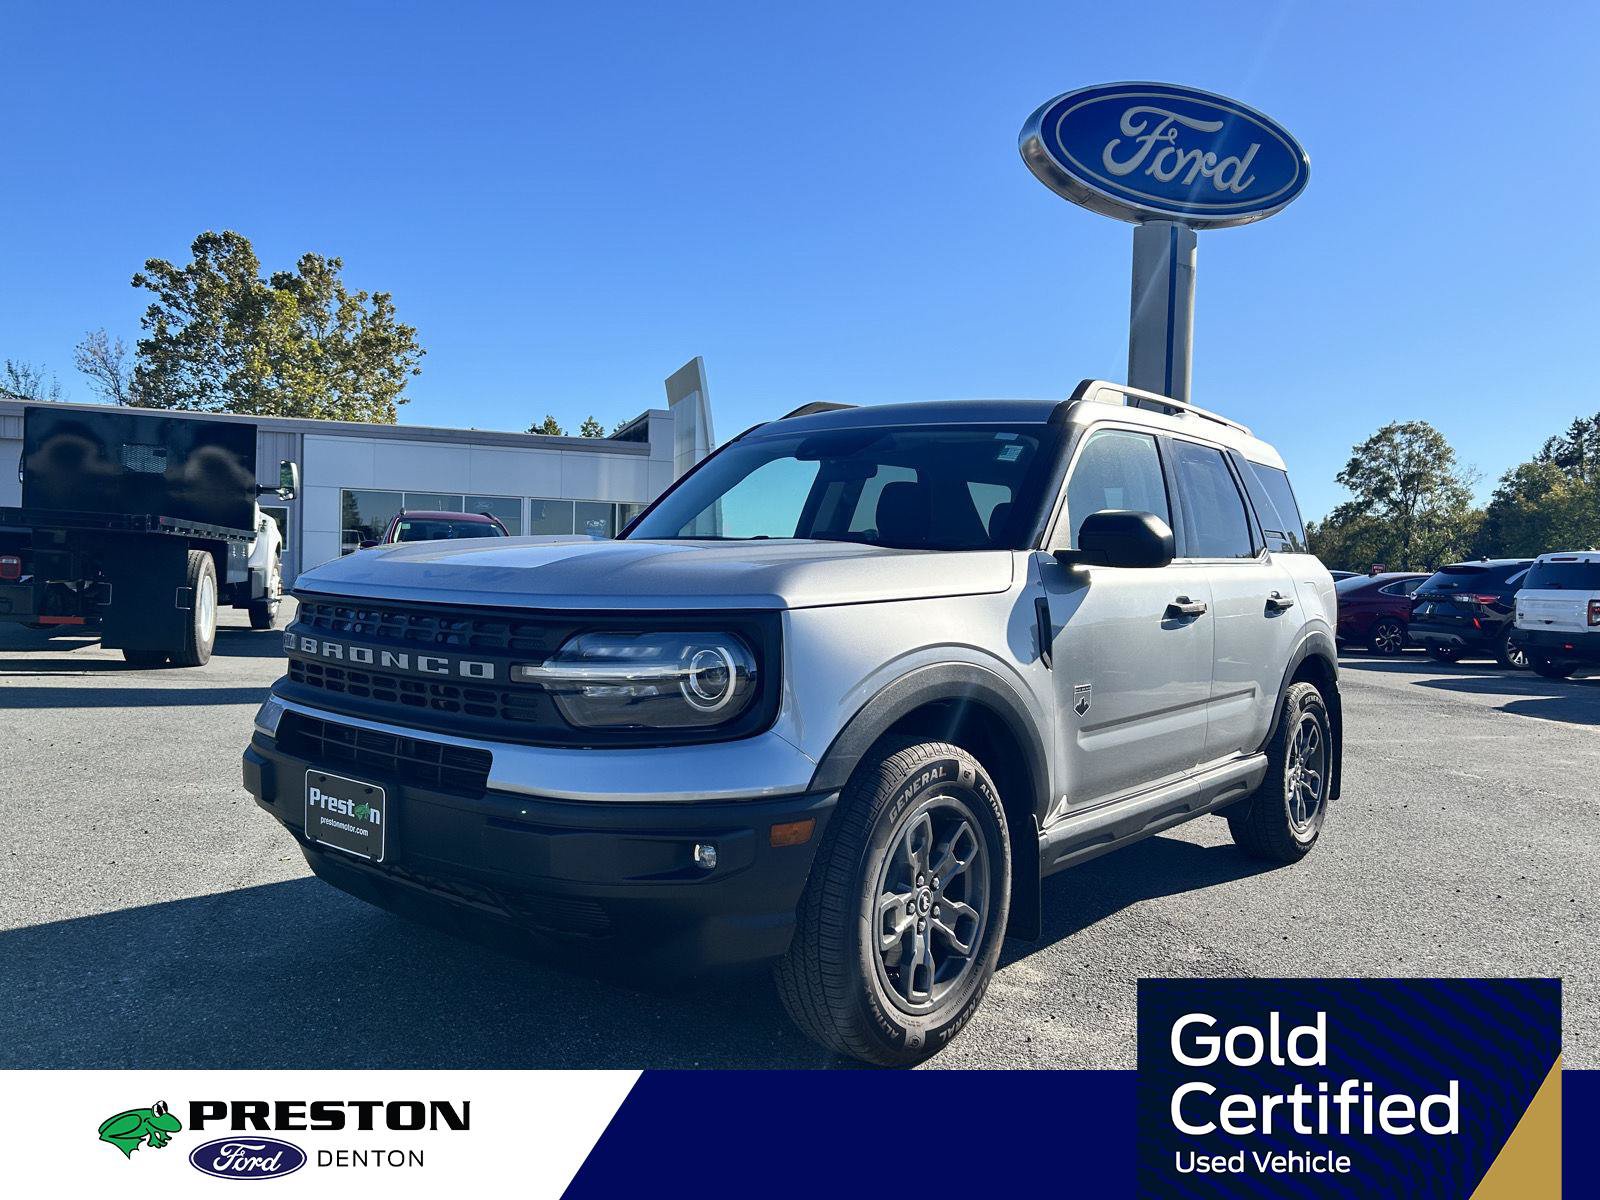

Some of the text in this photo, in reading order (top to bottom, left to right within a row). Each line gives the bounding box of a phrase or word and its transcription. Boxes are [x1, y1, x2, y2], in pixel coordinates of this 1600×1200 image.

[1102, 105, 1261, 194] Ford
[300, 636, 495, 679] BRONCO
[889, 766, 947, 824] GENERAL
[320, 816, 369, 837] prestonmotor.com
